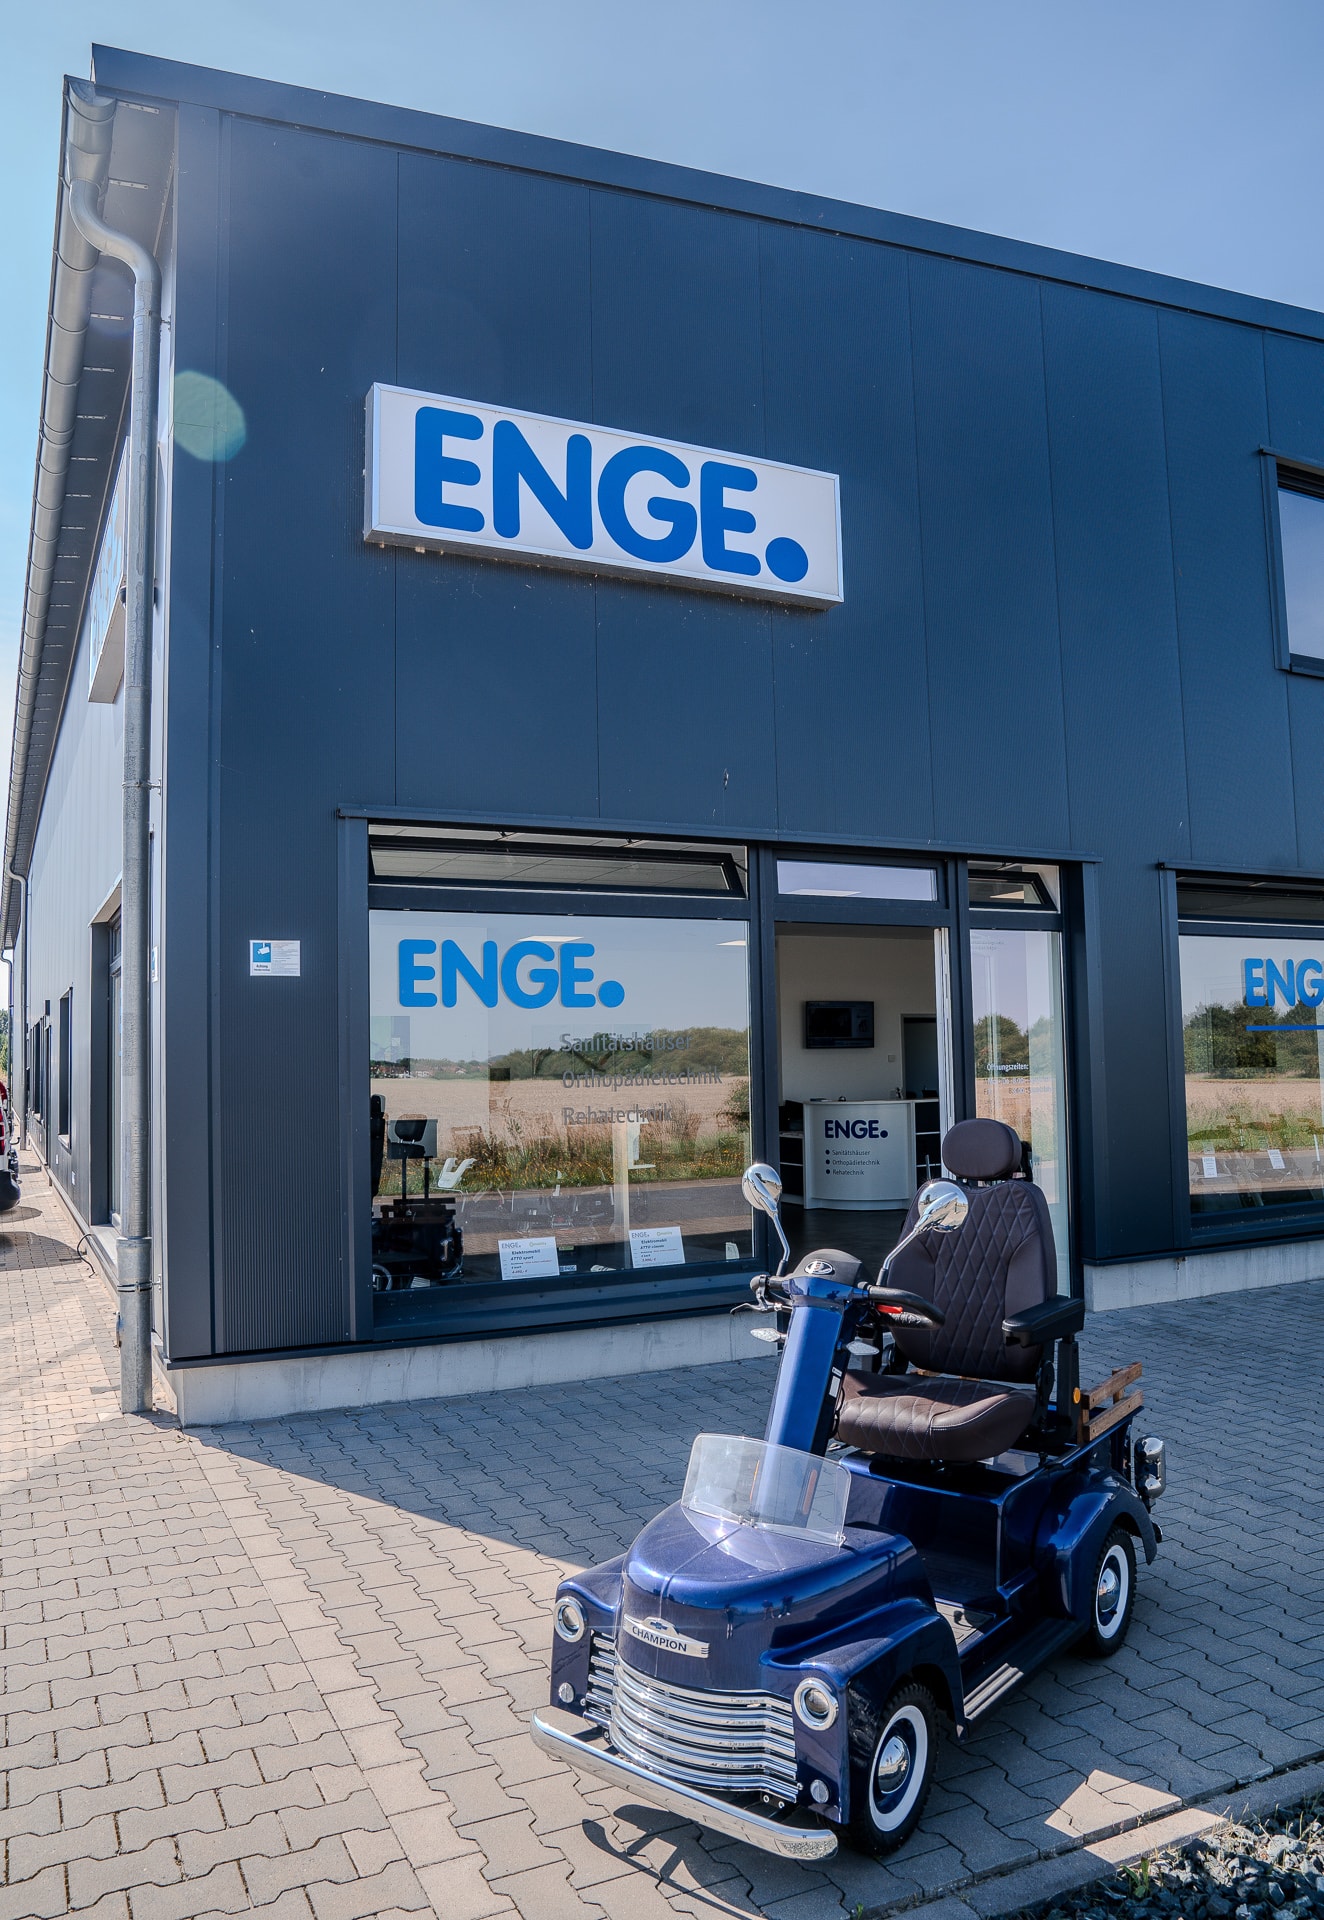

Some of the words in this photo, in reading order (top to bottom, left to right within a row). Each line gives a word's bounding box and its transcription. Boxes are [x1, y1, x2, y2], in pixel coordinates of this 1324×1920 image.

[415, 406, 809, 583] ENGE.
[398, 938, 625, 1009] ENGE.
[560, 1032, 692, 1051] Sanitätshäuser
[562, 1066, 722, 1092] Orthopädietechnik
[562, 1103, 673, 1126] Rehatechnik
[825, 1119, 888, 1139] ENGE.
[632, 1626, 687, 1652] CHAMPION
